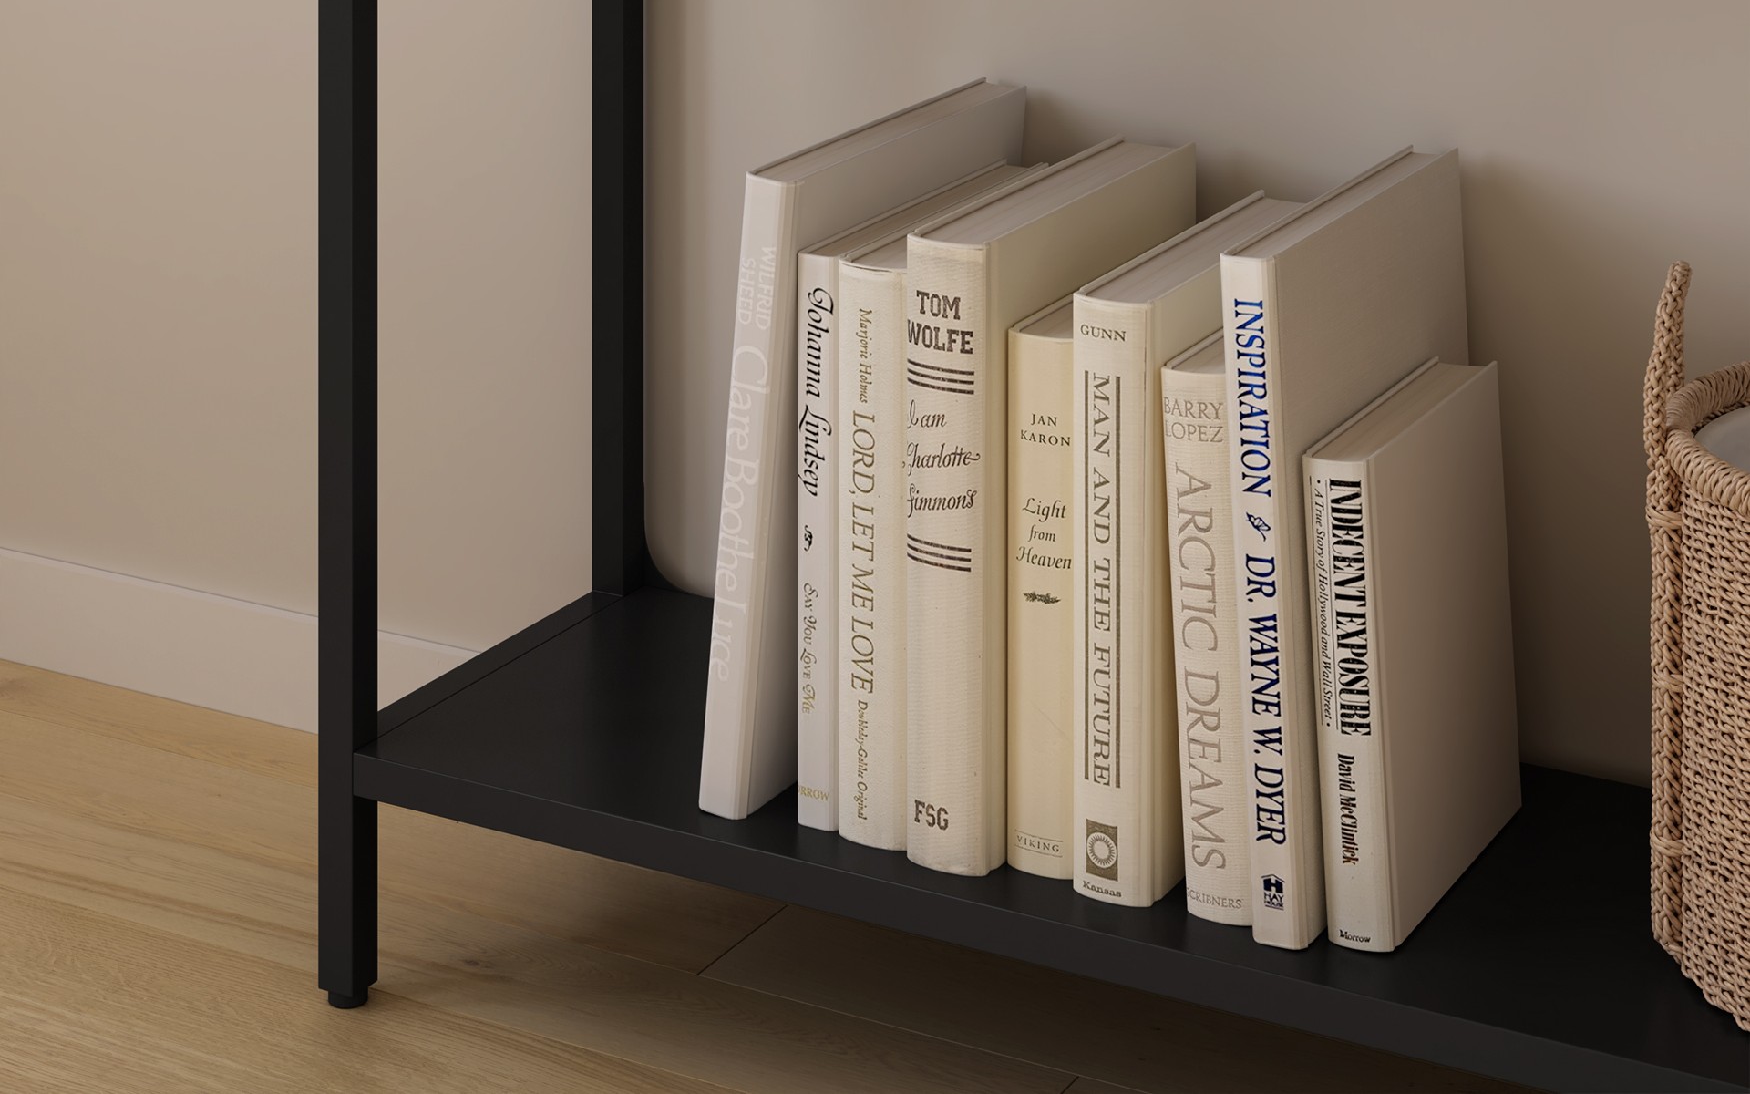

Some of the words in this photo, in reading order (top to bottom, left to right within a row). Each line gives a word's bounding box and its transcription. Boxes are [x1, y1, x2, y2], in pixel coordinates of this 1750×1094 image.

[737, 257, 756, 325] SHEED
[756, 246, 776, 330] WILFRID
[916, 290, 961, 320] TOM
[806, 287, 834, 398] Johanna
[857, 308, 872, 360] Marjorie
[907, 319, 974, 354] WOLFE
[1080, 324, 1127, 342] GUNN
[727, 346, 769, 450] Clare
[860, 364, 872, 404] Holmes
[1234, 298, 1273, 497] INSPIRATION
[921, 410, 948, 428] am
[1030, 414, 1057, 427] JAN
[1092, 373, 1111, 457] MAN
[1164, 396, 1224, 421] BARRY
[798, 404, 832, 497] Lindsey
[1020, 429, 1071, 447] KARON
[1165, 420, 1223, 443] LOPEZ
[849, 410, 876, 495] LORD,
[1021, 498, 1068, 523] Light
[1092, 467, 1112, 545] AND
[1313, 489, 1323, 498] A
[1314, 501, 1325, 526] True
[716, 456, 759, 591] Boothe
[851, 502, 875, 561] LET
[1027, 524, 1056, 545] from
[1313, 529, 1327, 558] Story
[1329, 479, 1366, 607] INDECENT
[1015, 546, 1072, 571] Heaven
[1175, 462, 1219, 651] ARCTIC
[1313, 560, 1327, 573] of
[851, 563, 875, 611] ME
[1092, 558, 1112, 632] THE
[1246, 554, 1278, 604] DR.
[1316, 574, 1330, 636] Hollywood
[711, 596, 747, 681] Luce
[850, 615, 875, 694] LOVE
[1320, 637, 1330, 658] and
[1249, 614, 1282, 717] WAYNE
[1322, 661, 1333, 687] Wall
[1334, 611, 1371, 736] EXPOSURE
[1092, 643, 1112, 786] FUTURE
[1323, 688, 1333, 719] Street
[1253, 726, 1283, 756] W.
[1184, 666, 1227, 870] DREAMS
[1338, 753, 1355, 792] David
[798, 785, 829, 801] RROW
[853, 782, 868, 821] Original
[1254, 763, 1287, 846] DYER
[914, 800, 950, 831] FSG
[1340, 794, 1359, 865] McClintick
[1016, 834, 1060, 853] VIKING
[1082, 881, 1122, 897] Kansas
[1339, 930, 1371, 943] Morrow
